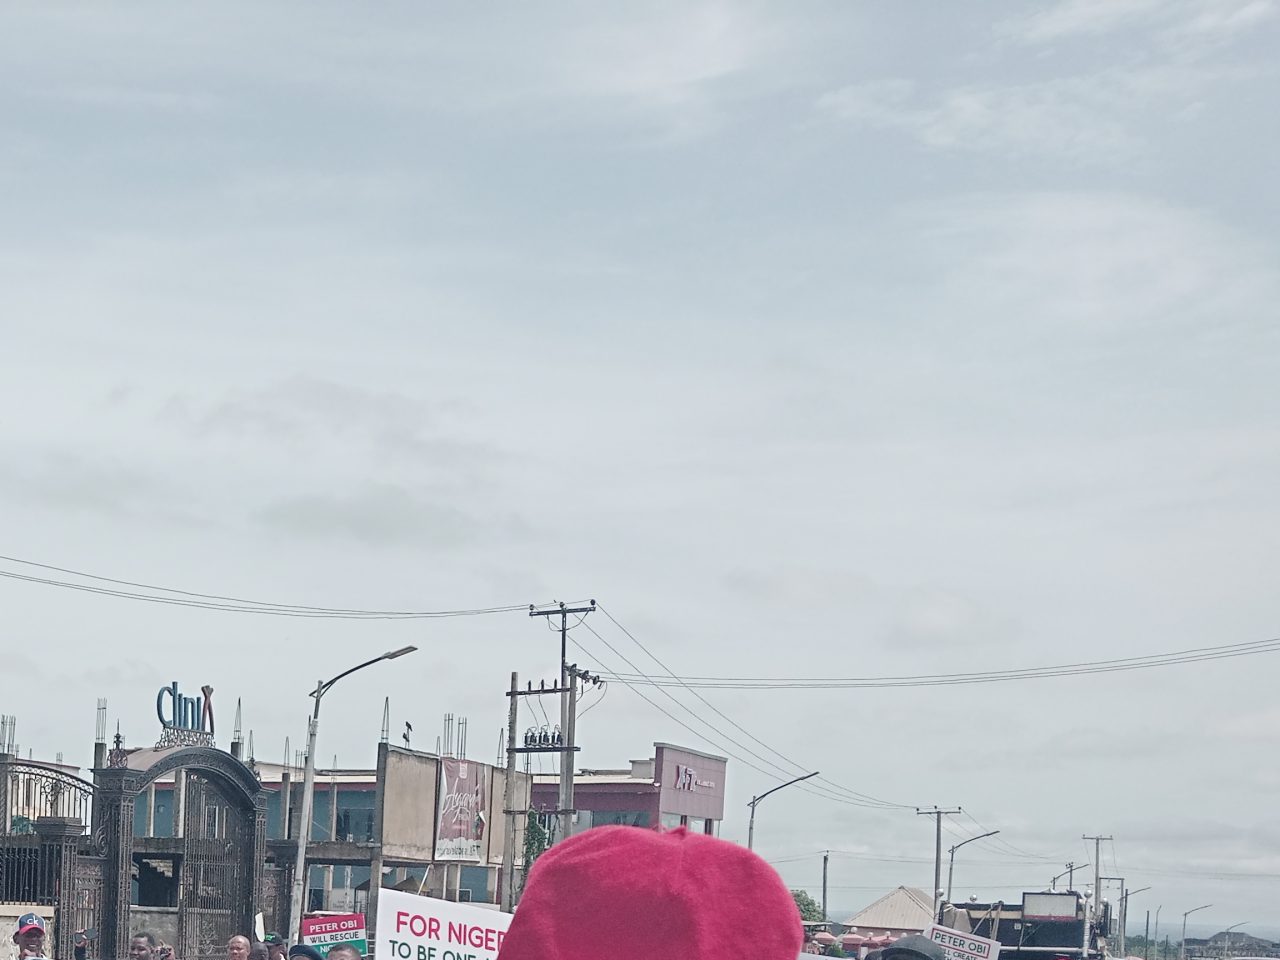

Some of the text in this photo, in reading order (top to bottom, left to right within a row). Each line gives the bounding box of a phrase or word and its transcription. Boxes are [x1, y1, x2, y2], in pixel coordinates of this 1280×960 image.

[310, 919, 357, 933] PETER OBI
[396, 911, 440, 941] FOR
[310, 931, 359, 943] WILL RESCUE
[934, 932, 987, 955] PETER OBI
[389, 939, 412, 959] TO
